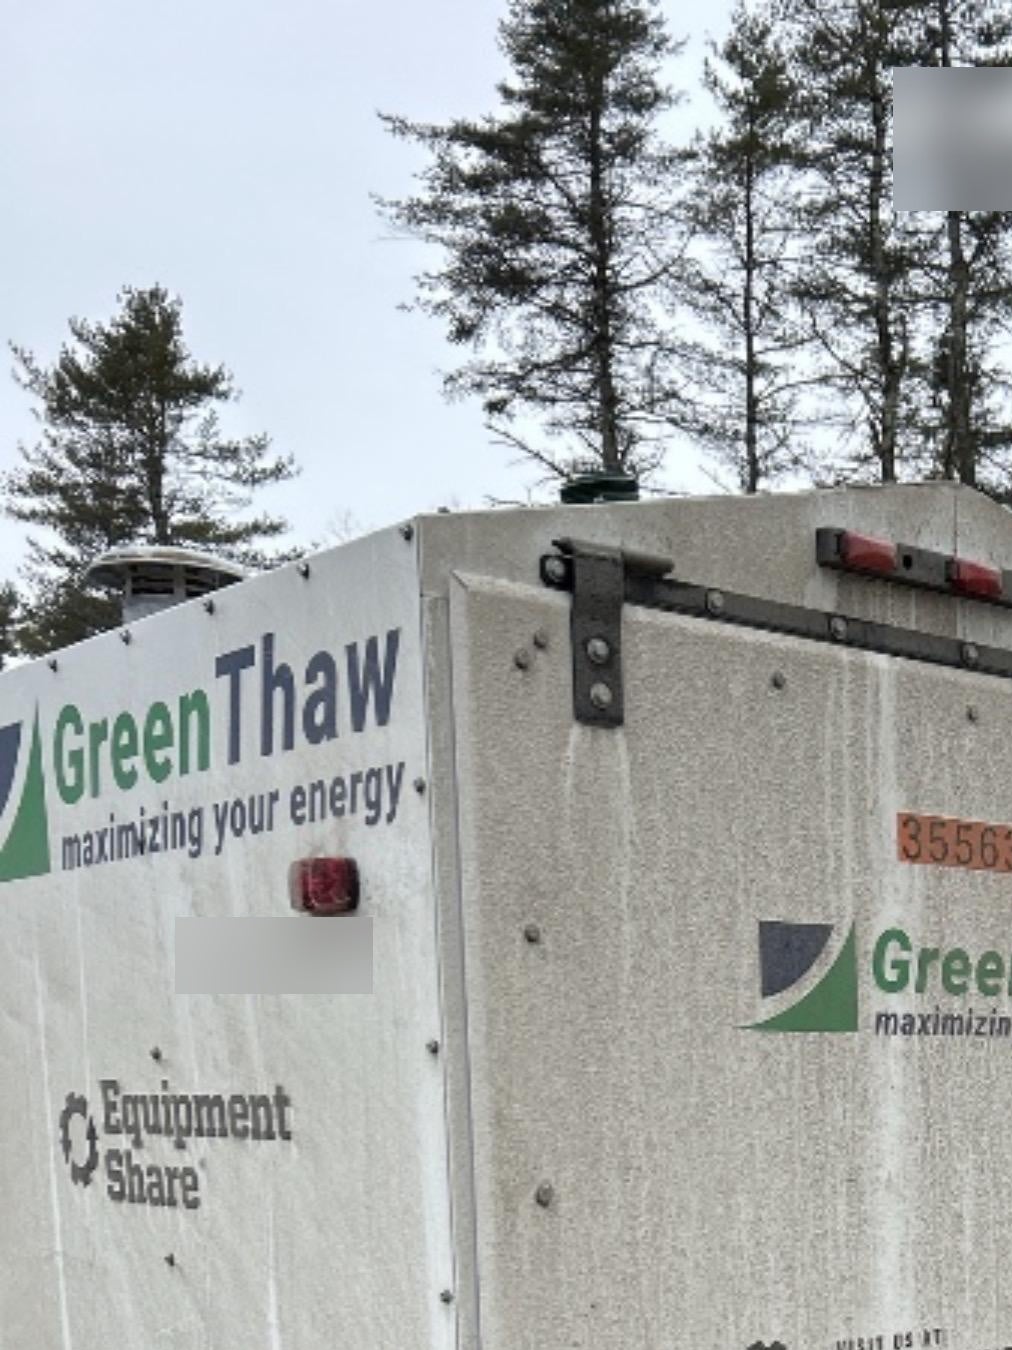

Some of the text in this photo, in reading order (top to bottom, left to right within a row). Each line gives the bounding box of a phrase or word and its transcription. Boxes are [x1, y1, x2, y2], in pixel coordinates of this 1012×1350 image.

[53, 627, 402, 804] GreenThaw
[61, 761, 406, 871] maximizing your energy
[101, 1079, 293, 1150] Equipment
[106, 1149, 201, 1209] Share
[893, 1331, 912, 1350] US
[922, 1328, 941, 1346] AT
